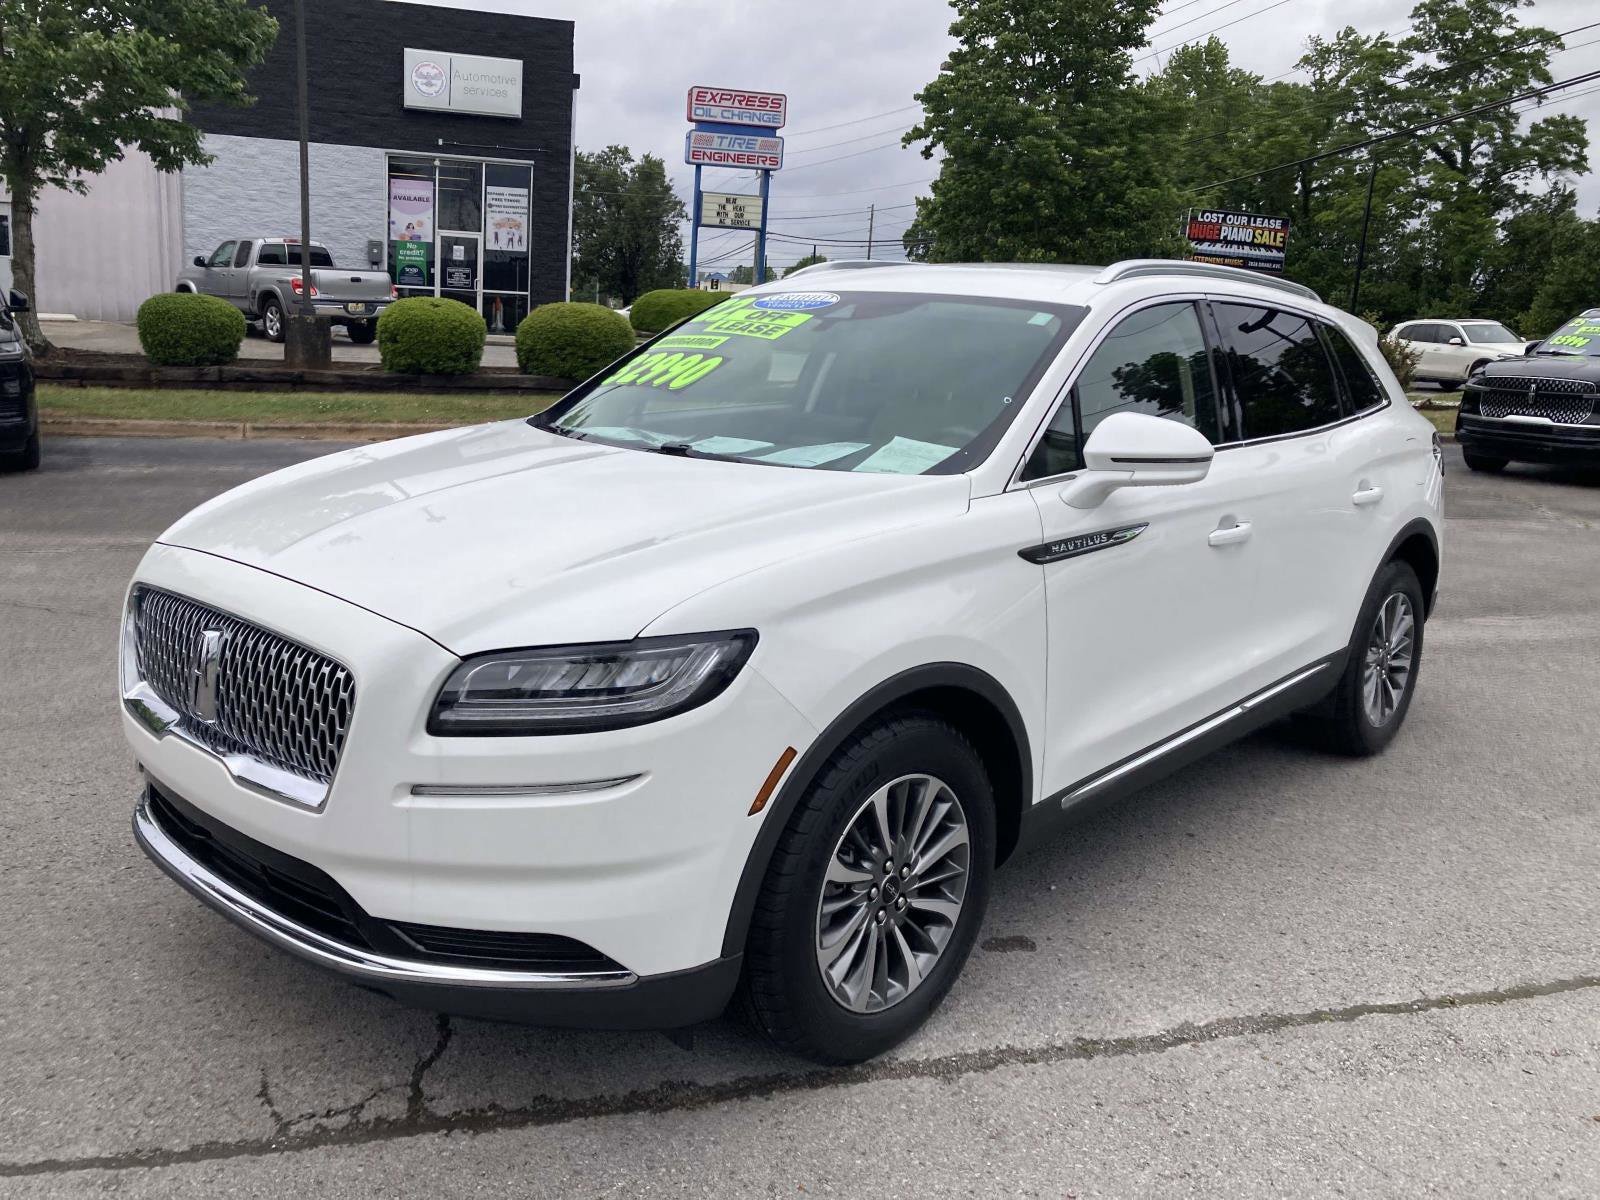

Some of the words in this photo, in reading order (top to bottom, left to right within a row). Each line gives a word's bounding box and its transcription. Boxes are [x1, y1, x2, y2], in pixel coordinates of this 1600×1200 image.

[453, 70, 517, 86] Automotive
[463, 86, 508, 98] services
[695, 91, 783, 109] EXPRESS
[694, 107, 717, 118] OIL
[721, 109, 781, 124] CHANGE
[716, 136, 758, 149] TIRE
[692, 151, 779, 166] ENGINEERS
[1198, 212, 1224, 223] LOST
[1226, 214, 1248, 226] OUR
[1250, 216, 1282, 230] LEASE
[1190, 223, 1219, 239] HUGE
[1220, 226, 1253, 242] PIANO
[1254, 229, 1284, 247] SALE
[744, 311, 795, 322] OFF
[713, 321, 787, 336] LEASE
[1051, 533, 1108, 553] NAUTILUS
